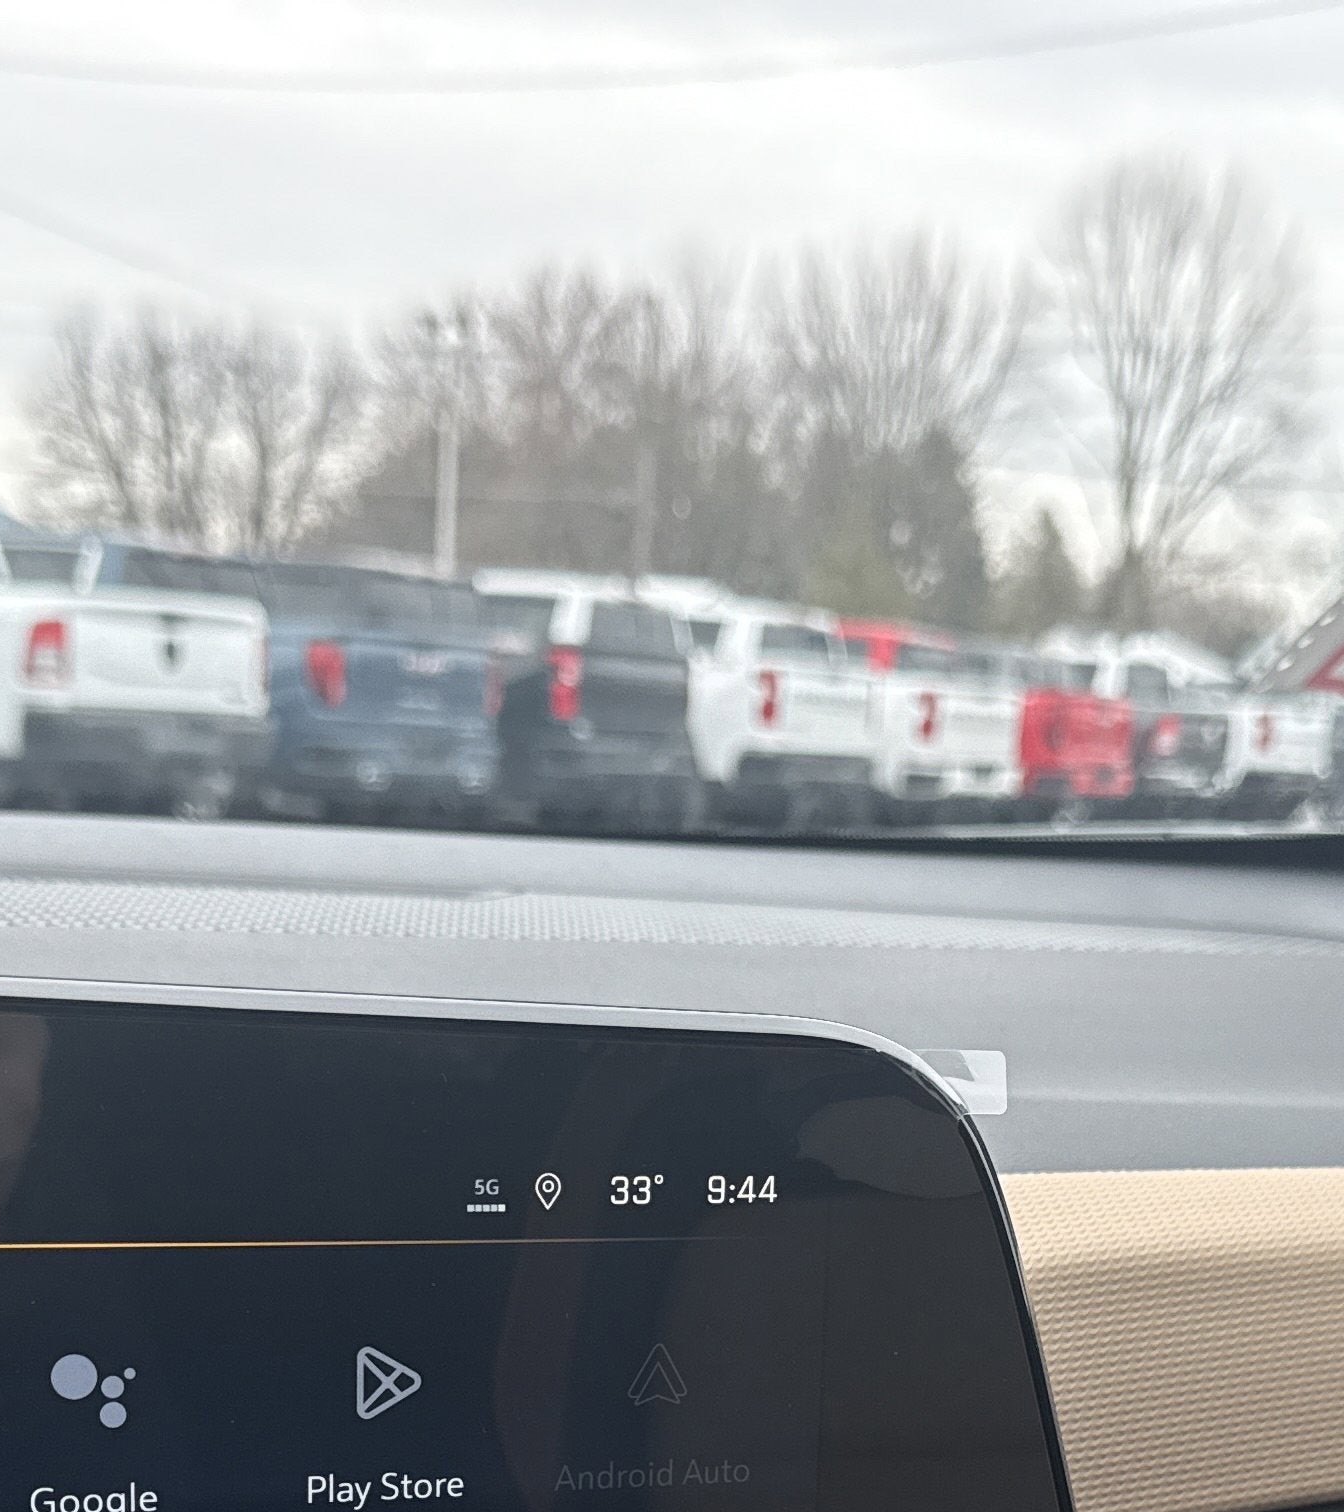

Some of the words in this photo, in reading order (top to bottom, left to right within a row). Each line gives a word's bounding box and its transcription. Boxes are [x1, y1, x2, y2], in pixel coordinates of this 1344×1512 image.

[474, 1178, 500, 1196] 5G
[610, 1174, 664, 1205] 33°
[707, 1175, 779, 1204] 9:44
[554, 1457, 674, 1492] Android
[682, 1457, 751, 1485] Auto
[306, 1472, 372, 1511] Play
[379, 1472, 465, 1501] Store
